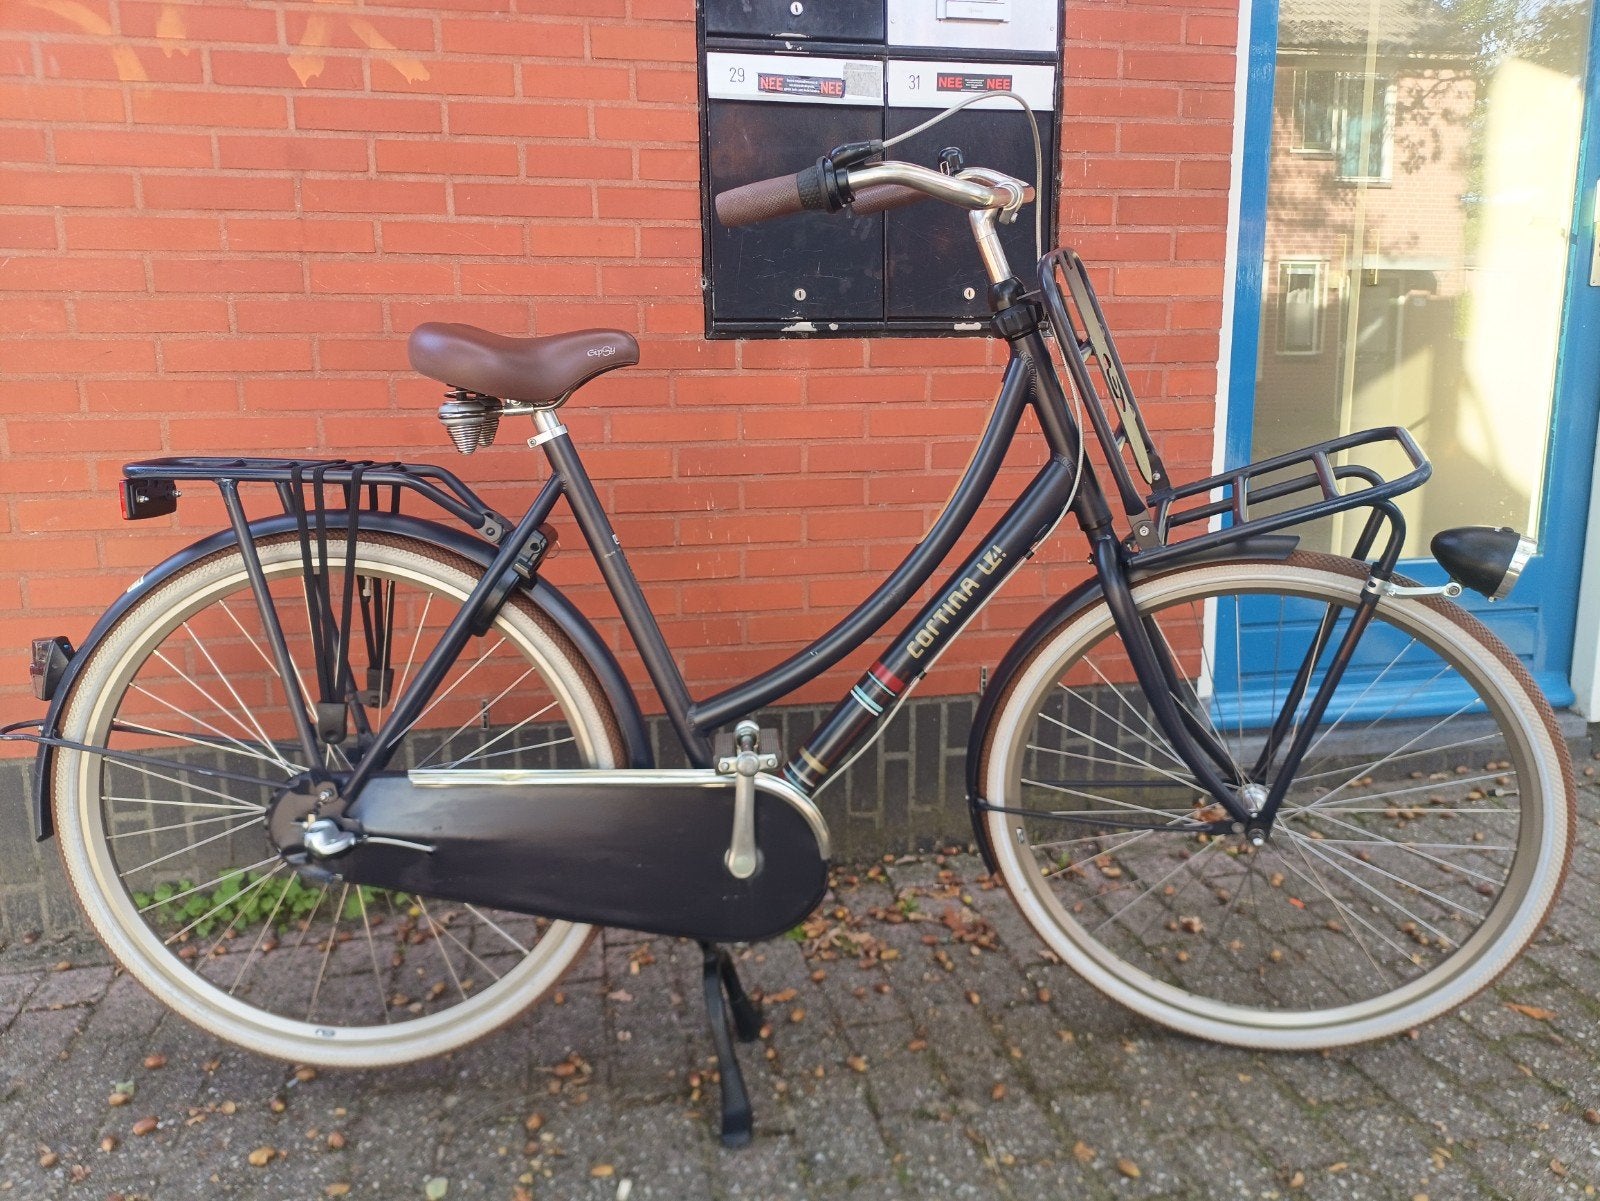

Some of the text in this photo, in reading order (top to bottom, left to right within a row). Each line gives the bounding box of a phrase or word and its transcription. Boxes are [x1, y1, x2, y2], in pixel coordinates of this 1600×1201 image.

[729, 67, 746, 83] 29
[908, 74, 921, 90] 31
[760, 76, 784, 91] NEE
[820, 80, 843, 95] NEE
[938, 77, 963, 89] NEE
[986, 78, 1010, 90] NEE
